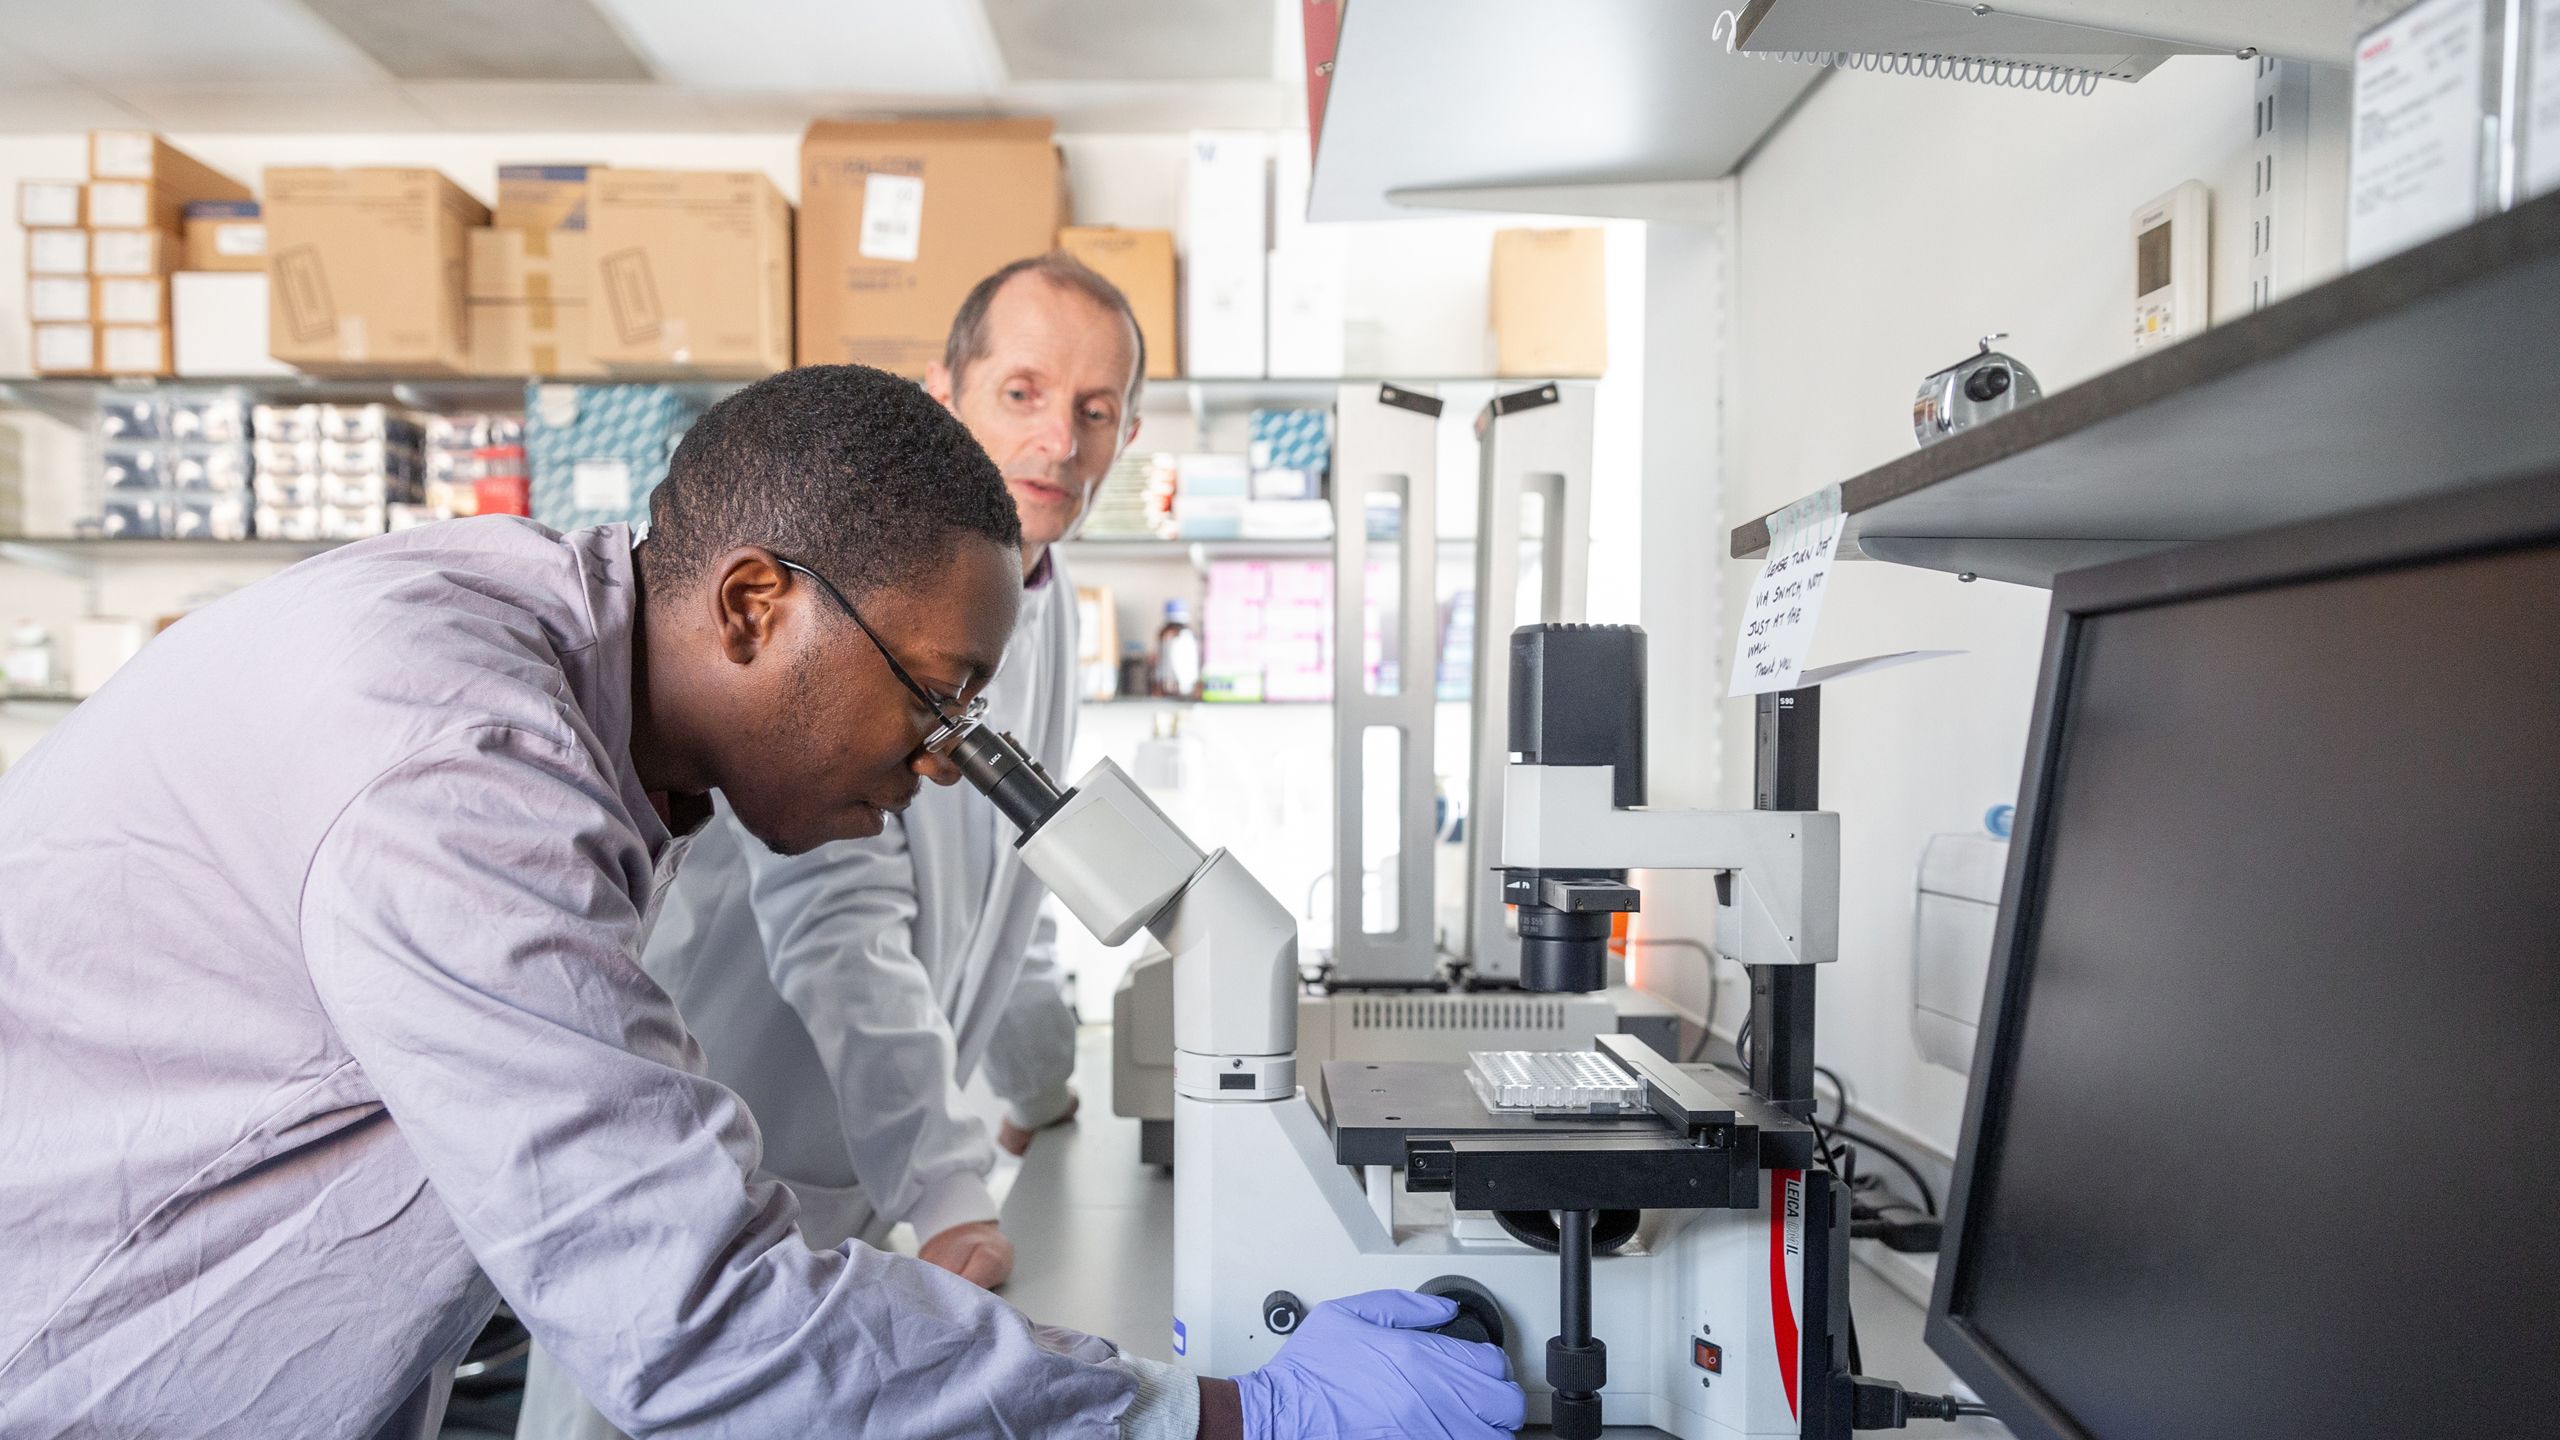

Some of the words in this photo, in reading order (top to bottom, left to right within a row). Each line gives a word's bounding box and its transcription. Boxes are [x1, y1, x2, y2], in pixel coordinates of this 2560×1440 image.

[1764, 556, 1789, 578] PLEASE
[1816, 536, 1832, 558] OFF
[1756, 590, 1769, 608] VIA
[1807, 572, 1824, 591] NOT
[1747, 619, 1771, 637] JUST
[1773, 612, 1785, 628] AT
[1754, 656, 1776, 679] Thank
[1787, 1181, 1799, 1217] LEICA
